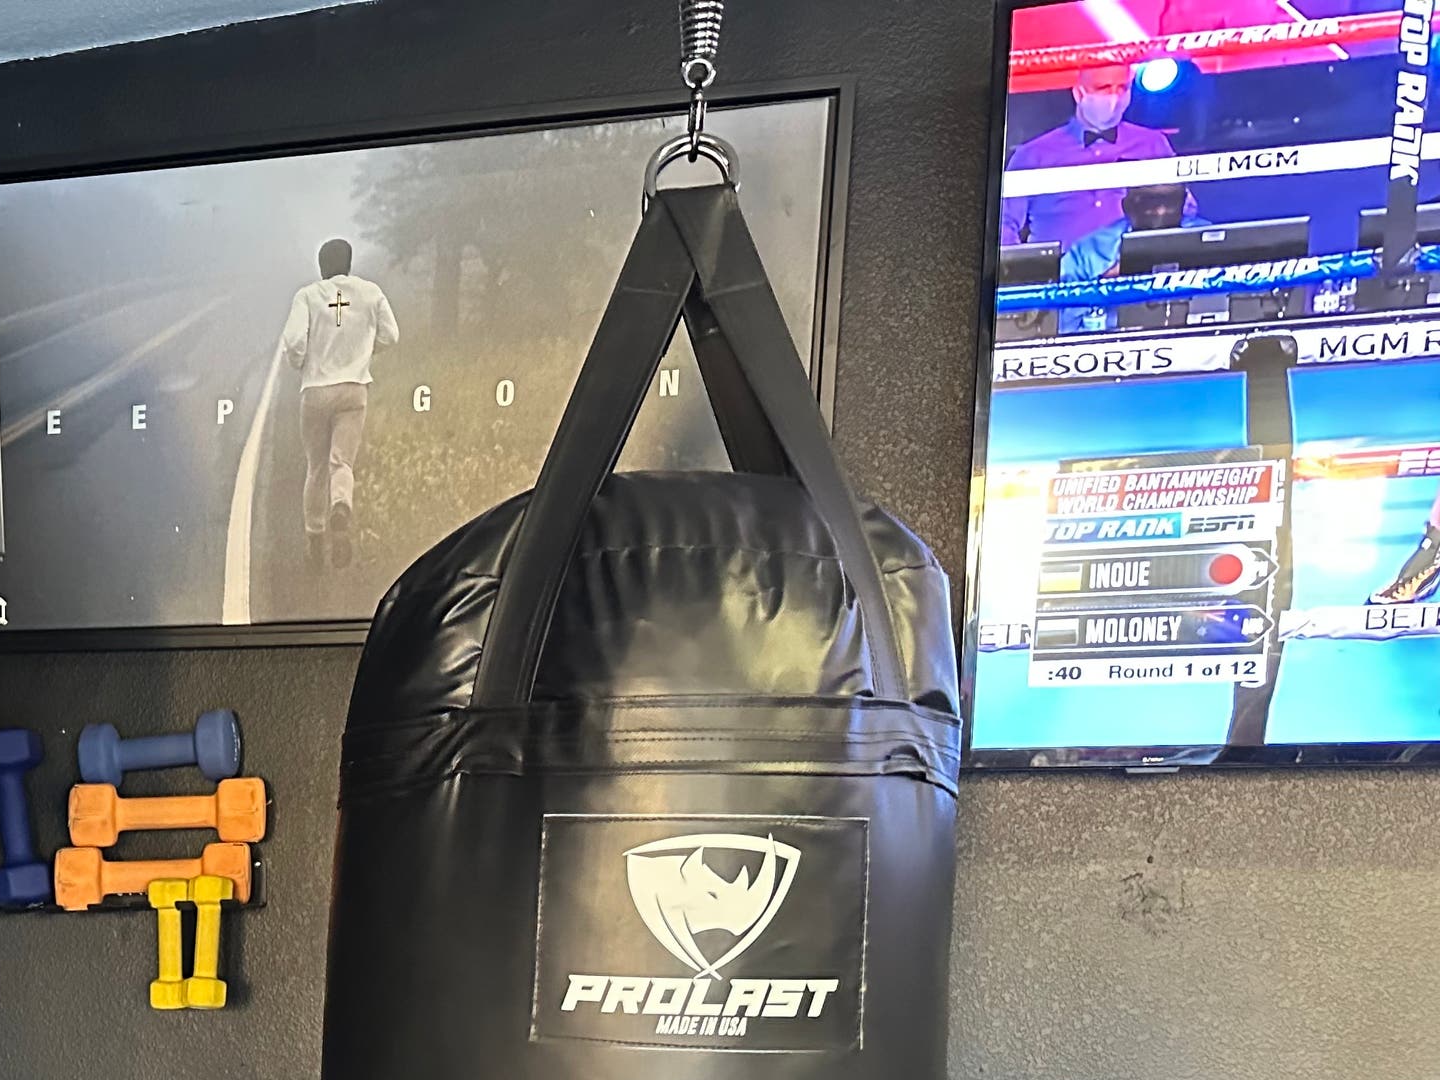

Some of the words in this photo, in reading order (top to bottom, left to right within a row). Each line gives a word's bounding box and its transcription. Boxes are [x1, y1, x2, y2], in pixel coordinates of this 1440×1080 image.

[1389, 71, 1427, 186] RANK
[1319, 331, 1409, 358] MGM
[1001, 347, 1173, 379] RESORTS
[1053, 475, 1121, 497] UNIFIED
[1124, 466, 1266, 493] BANTAMWEIGHT
[1056, 493, 1119, 515] WORLD
[1122, 486, 1259, 511] CHAMPIONSHIP
[1045, 521, 1097, 543] TOP
[1096, 517, 1176, 540] RANK
[1185, 514, 1256, 535] ESPN
[1089, 561, 1151, 589] INOUE
[1085, 615, 1183, 644] MOLONEY
[1048, 666, 1082, 681] :40
[1109, 663, 1174, 680] Round
[1184, 662, 1193, 677] 1
[1202, 663, 1221, 677] of
[1230, 661, 1257, 676] 12
[561, 974, 839, 1018] PROLAST
[655, 1015, 700, 1035] MADE
[699, 1016, 719, 1036] IN
[718, 1016, 748, 1037] USA
